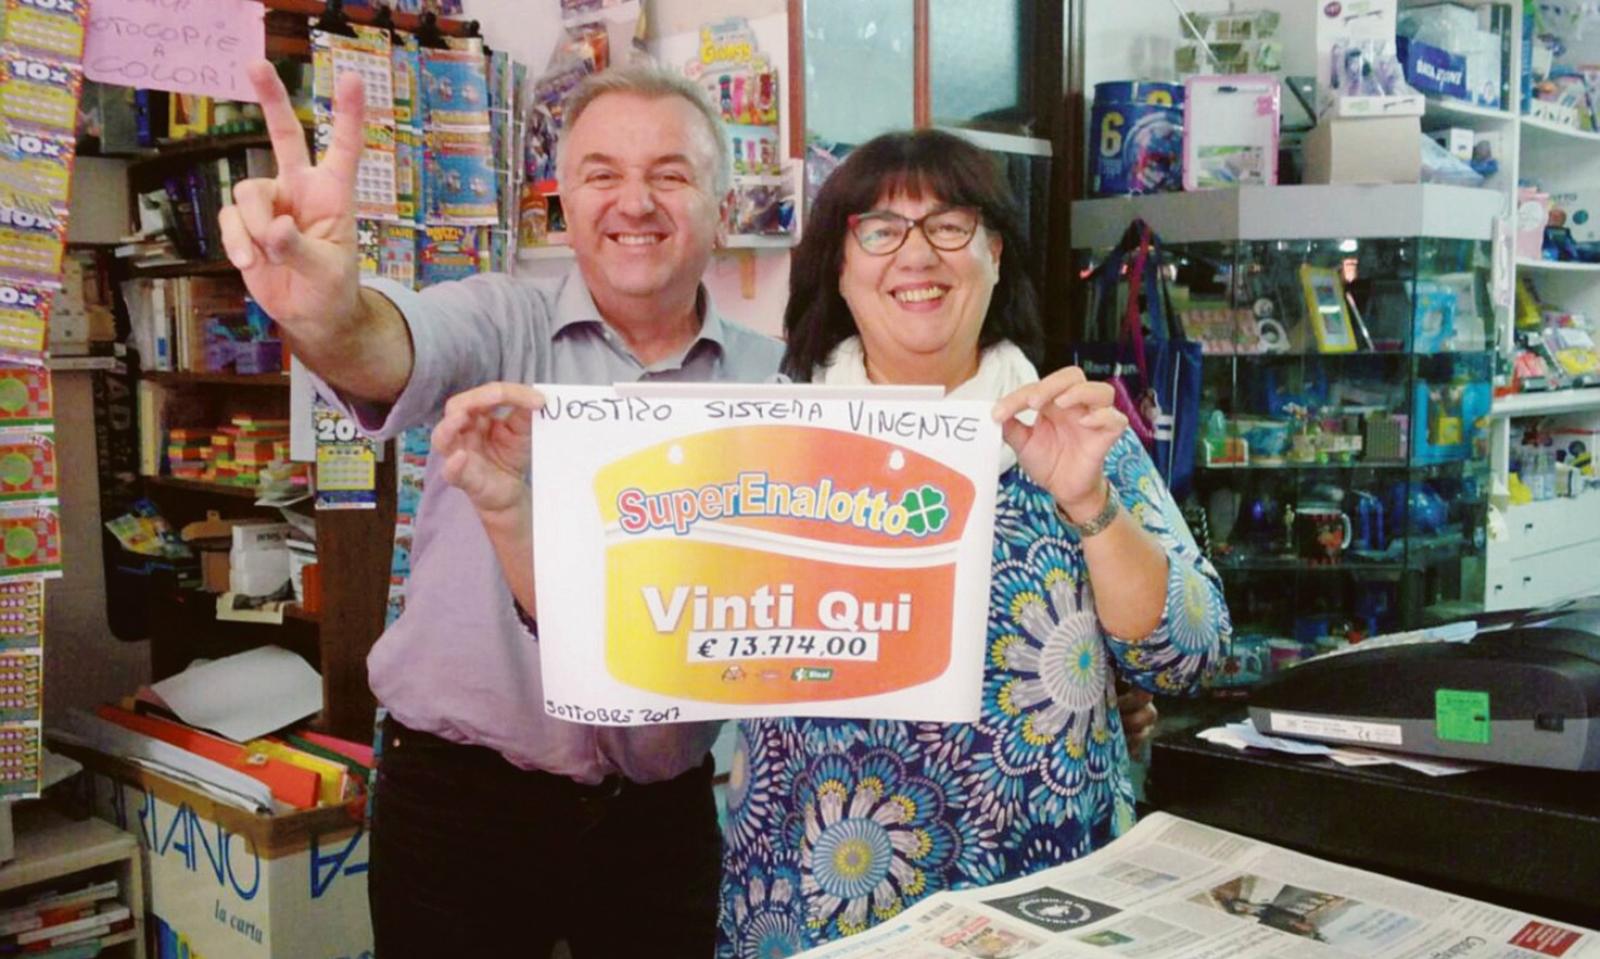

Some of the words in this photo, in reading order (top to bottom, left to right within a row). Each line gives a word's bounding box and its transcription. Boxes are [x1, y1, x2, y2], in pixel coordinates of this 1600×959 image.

[153, 42, 165, 57] A
[1101, 112, 1124, 157] 6
[316, 416, 358, 443] 20
[540, 396, 672, 422] NOSTRO
[705, 399, 823, 421] SISTEMA
[848, 400, 980, 442] VINENTE
[617, 471, 911, 537] SuperEnalotto
[640, 583, 795, 632] Vinti
[817, 588, 912, 633] Qui
[697, 638, 718, 658] €
[640, 706, 680, 722] 2017
[215, 899, 227, 923] la
